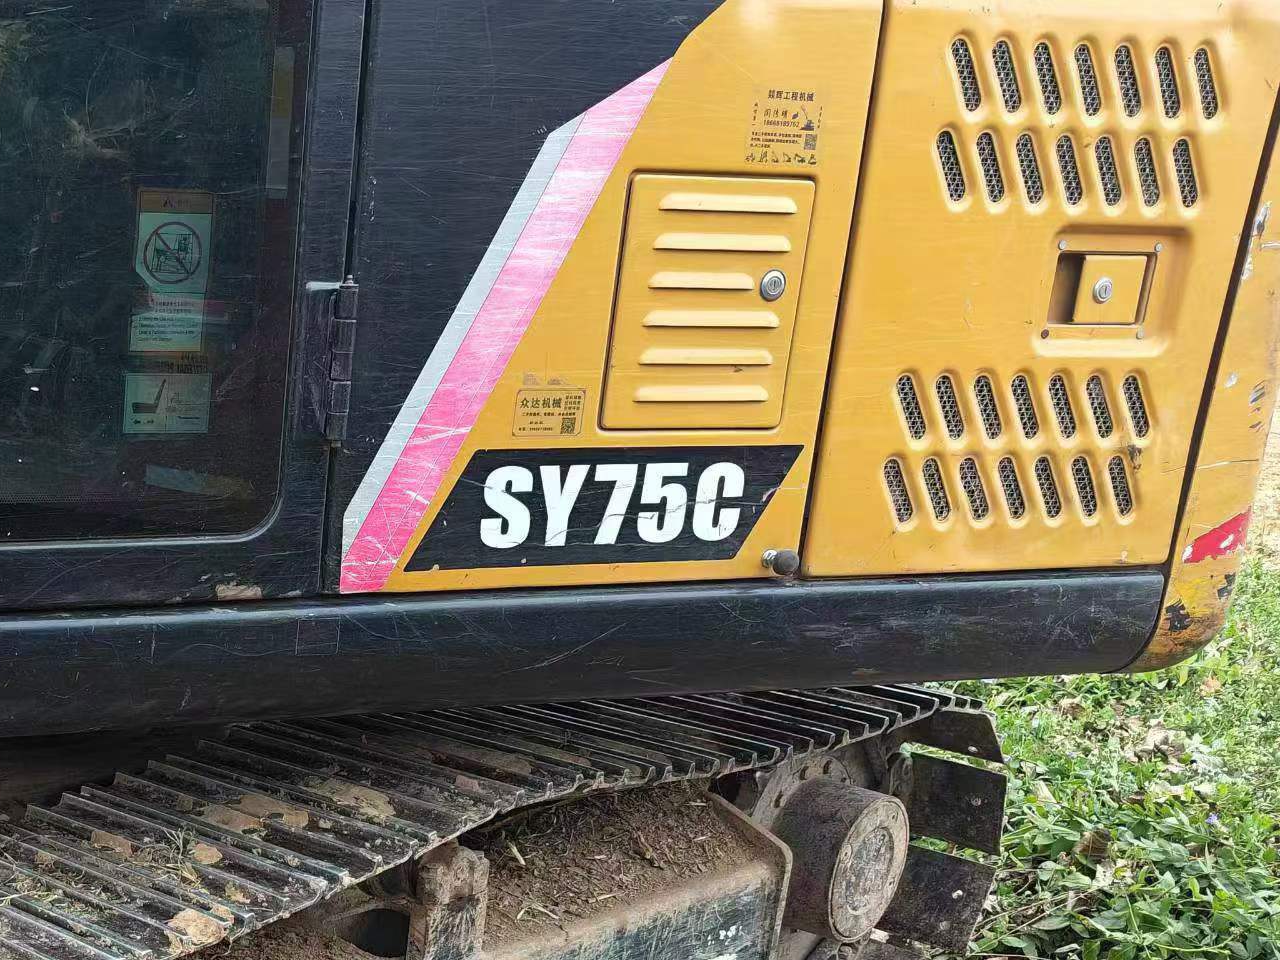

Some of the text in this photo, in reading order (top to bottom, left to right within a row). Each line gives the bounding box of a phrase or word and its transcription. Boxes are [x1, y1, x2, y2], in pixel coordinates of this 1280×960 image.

[519, 396, 562, 409] 众达机械
[480, 462, 745, 549] SY75C
